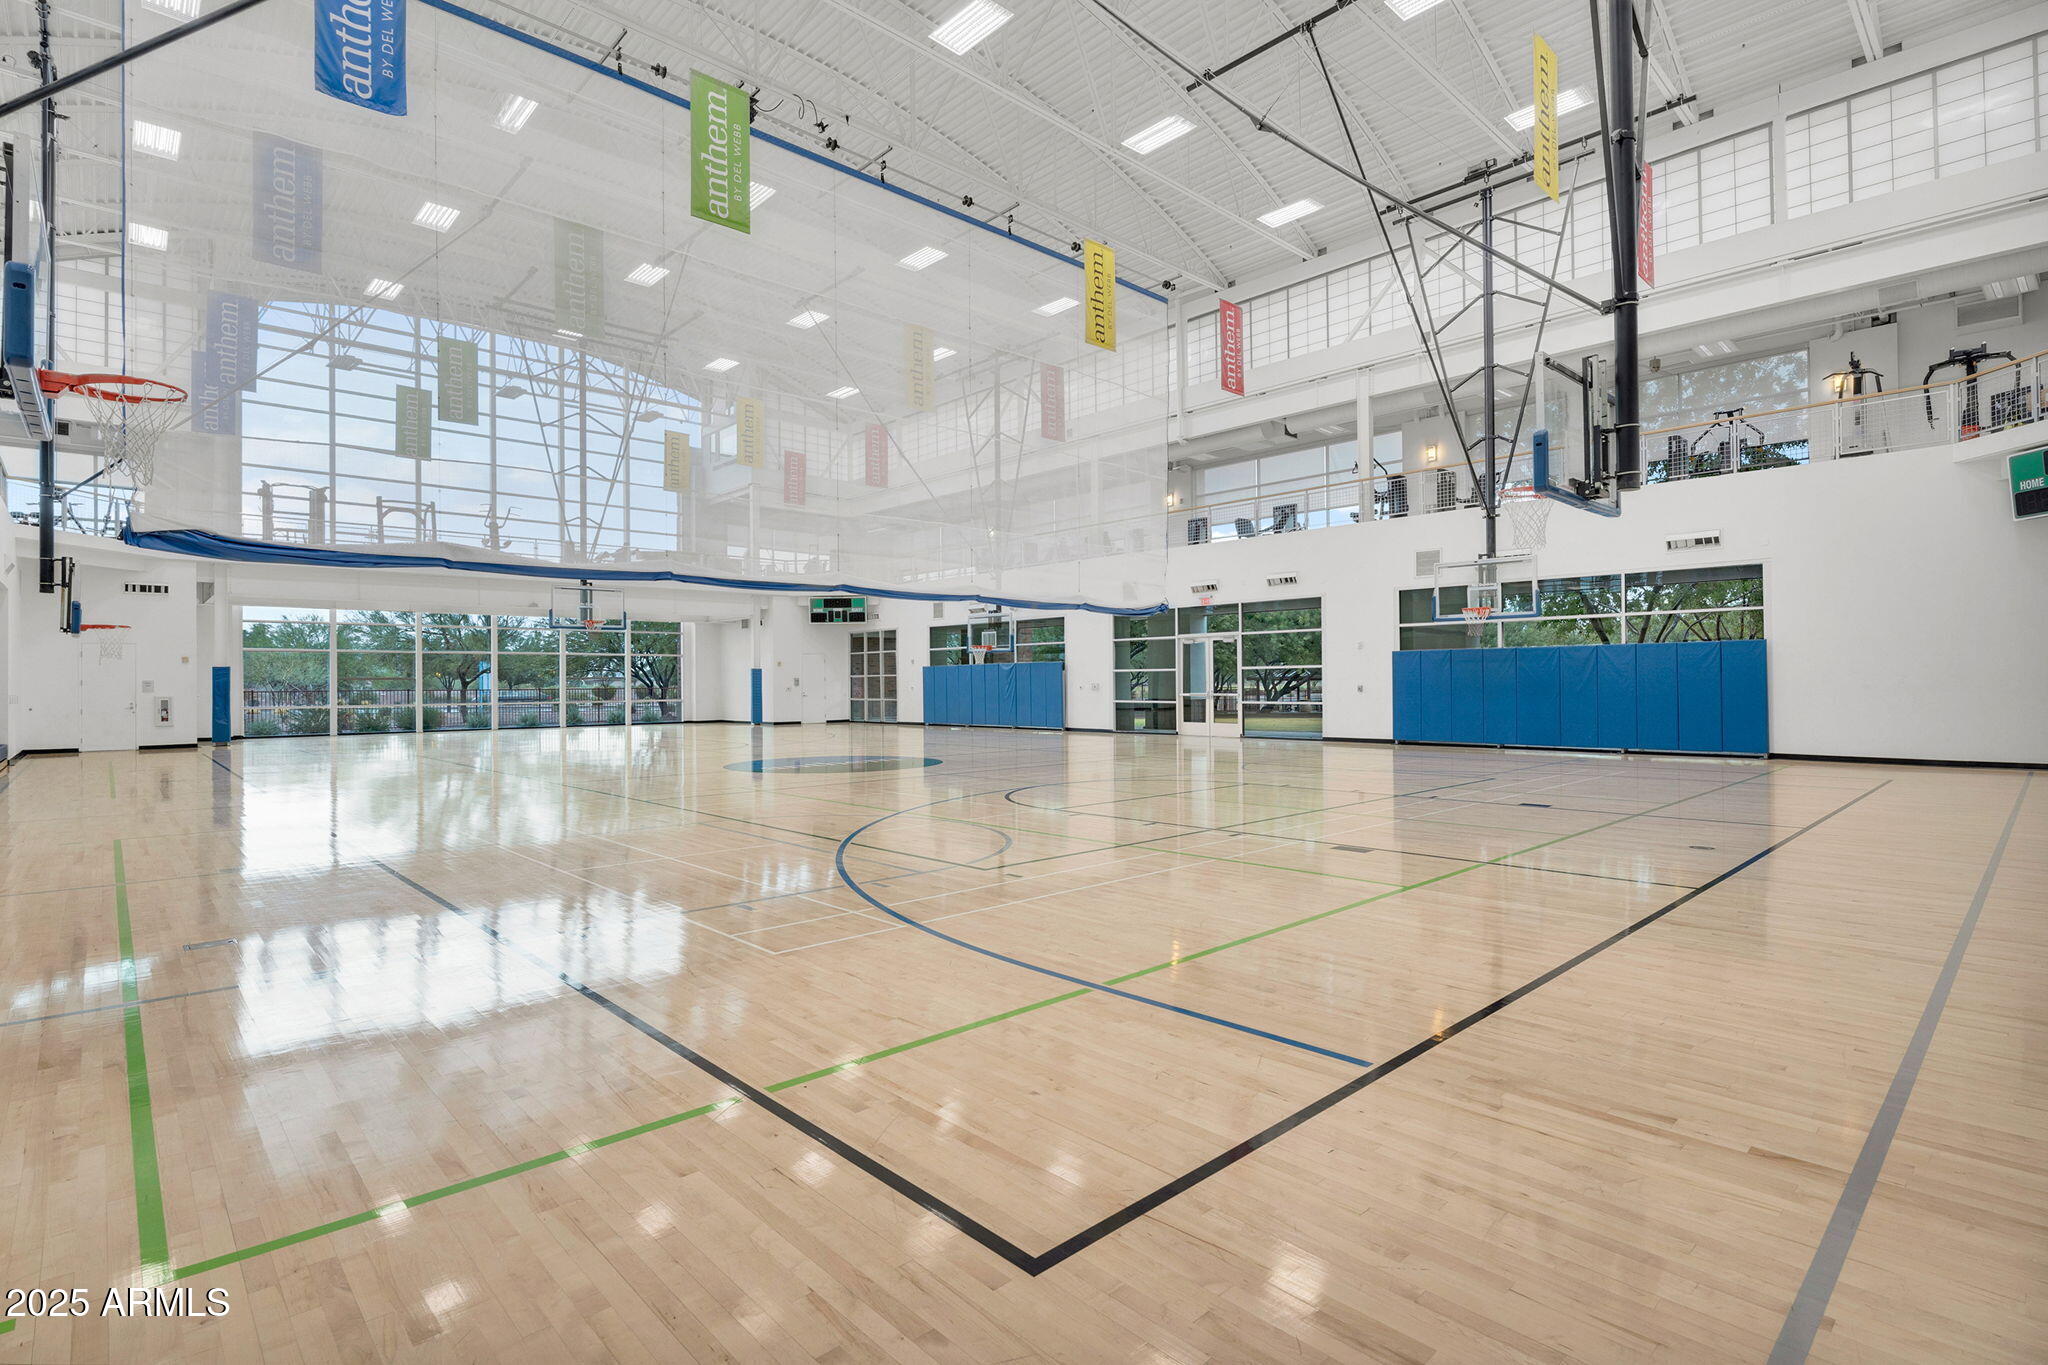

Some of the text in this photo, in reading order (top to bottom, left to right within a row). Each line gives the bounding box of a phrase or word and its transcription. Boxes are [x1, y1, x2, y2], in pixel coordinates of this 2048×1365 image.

[382, 28, 394, 55] DEL
[382, 59, 394, 79] BY
[701, 90, 729, 219] anthem
[1538, 54, 1551, 187] anthem
[733, 123, 743, 202] BY DEL WEBB
[264, 147, 296, 262] anthem
[1091, 252, 1106, 343] anthem
[214, 302, 239, 384] anthem
[444, 345, 464, 420] anthem
[1225, 310, 1236, 390] anthem
[401, 392, 419, 456] anthem
[2020, 477, 2045, 490] HOME
